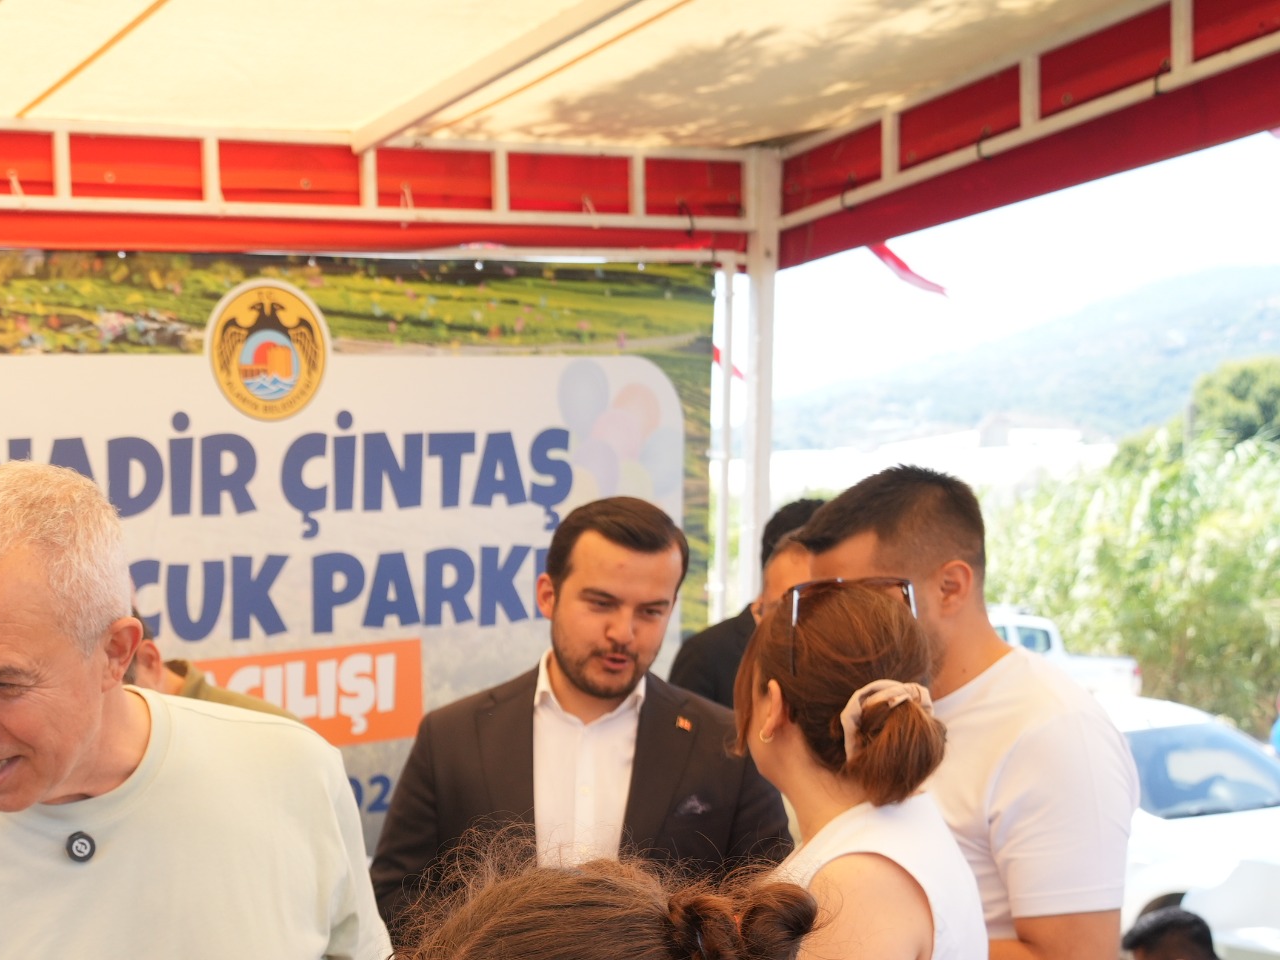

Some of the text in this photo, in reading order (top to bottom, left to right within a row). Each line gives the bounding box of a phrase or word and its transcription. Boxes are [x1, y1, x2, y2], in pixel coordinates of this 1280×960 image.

[281, 410, 573, 538] ÇİNTAŞ
[129, 554, 289, 642] CUK
[205, 653, 396, 735] ILIŞI
